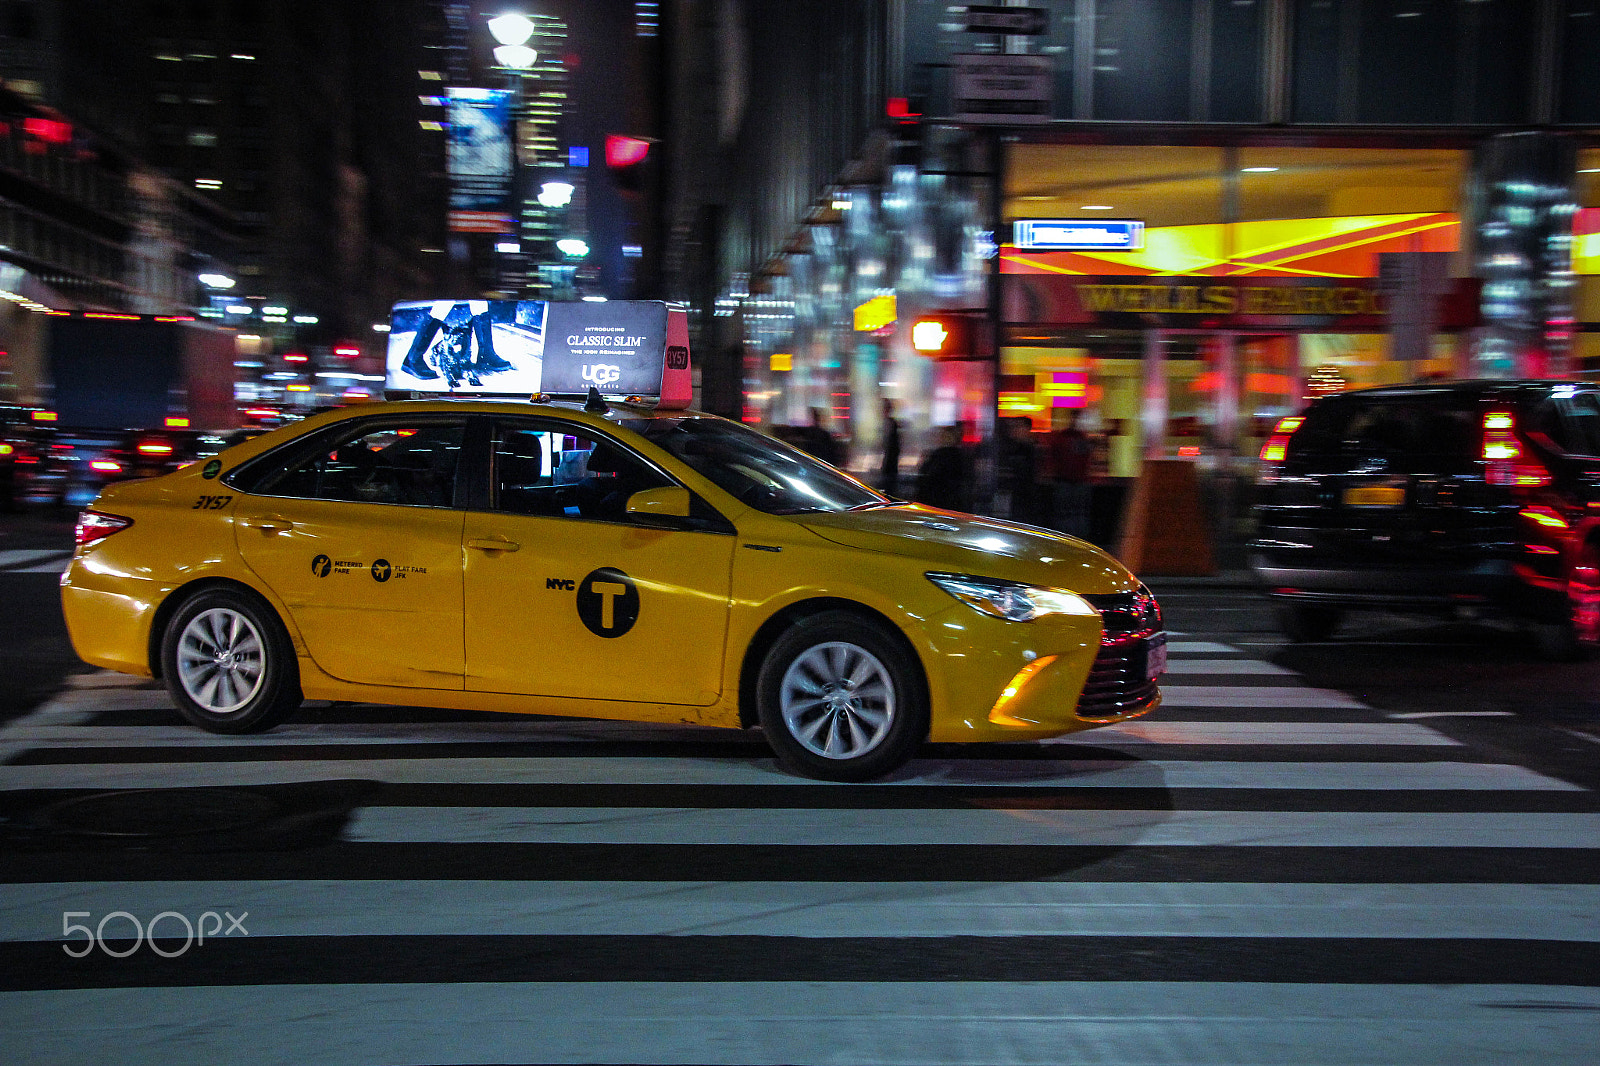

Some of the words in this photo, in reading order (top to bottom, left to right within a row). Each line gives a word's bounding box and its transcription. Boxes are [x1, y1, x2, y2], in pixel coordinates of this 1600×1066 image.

[1074, 284, 1238, 314] WELLS
[566, 335, 613, 347] CLASSIC
[667, 350, 686, 365] 3Y57
[581, 363, 620, 385] UGG
[192, 495, 233, 510] 3Y57
[394, 565, 410, 573] FLAT
[411, 566, 428, 574] FARE
[546, 578, 575, 591] NYC
[591, 581, 626, 629] T
